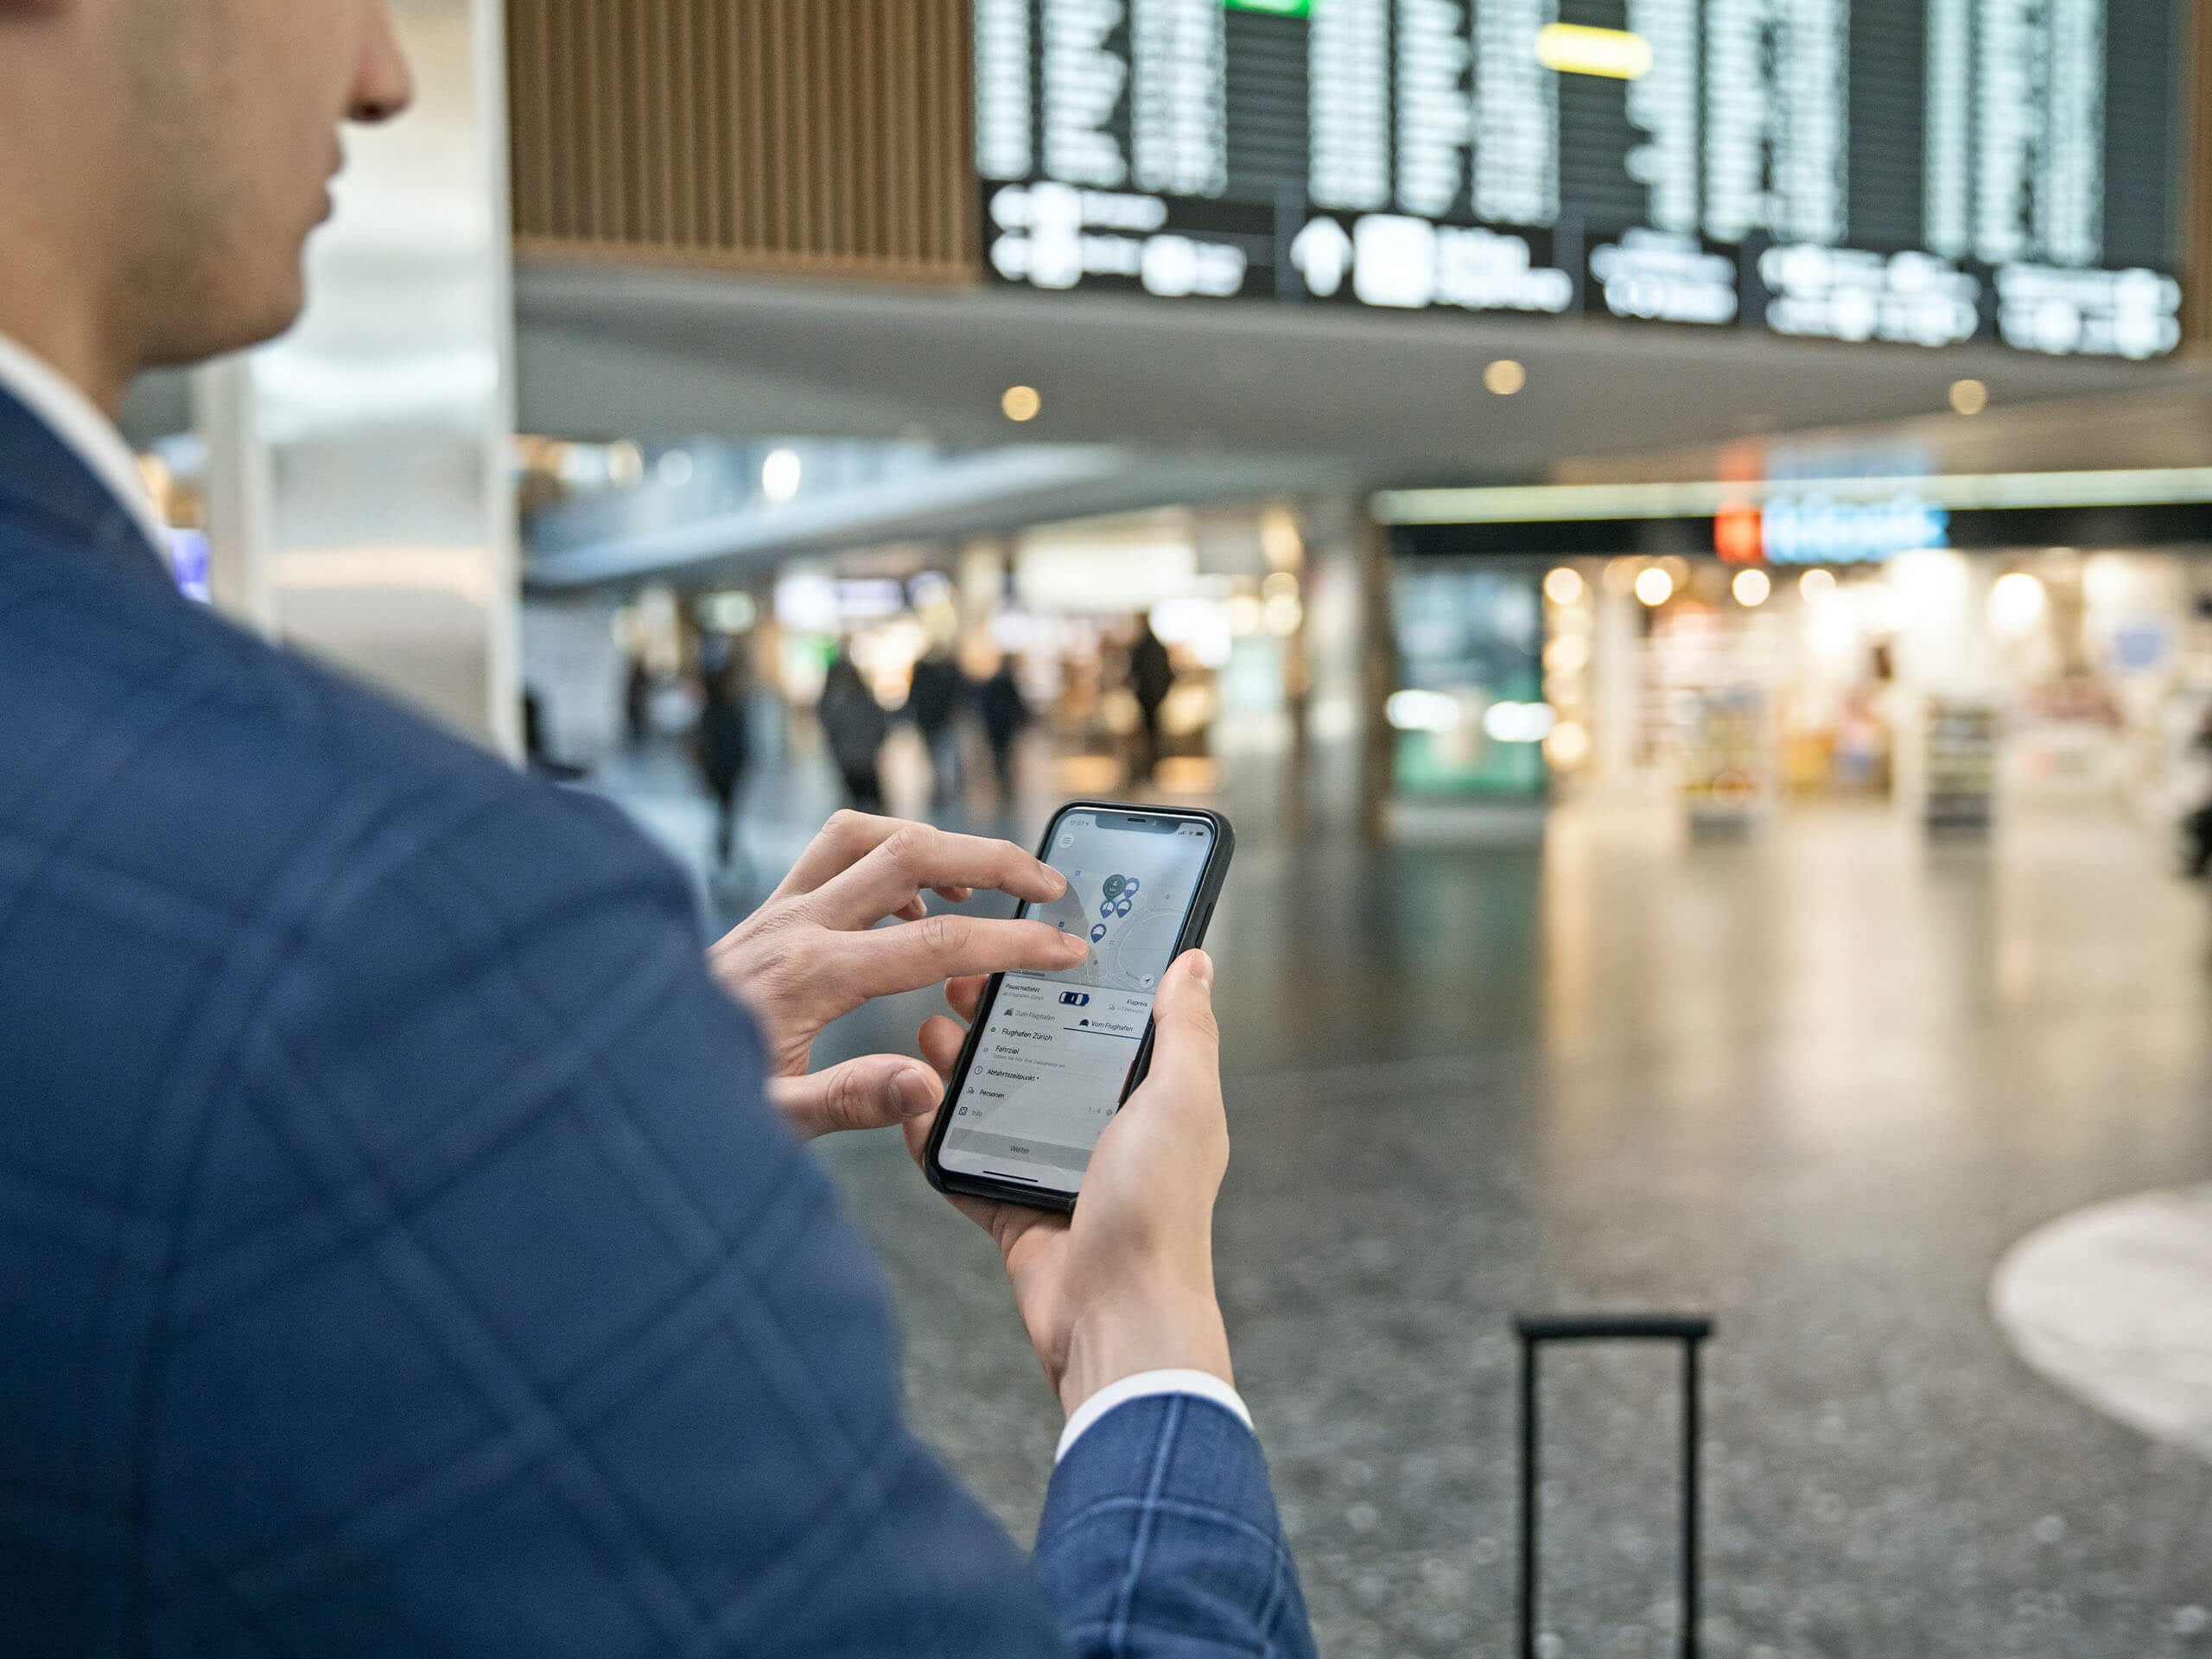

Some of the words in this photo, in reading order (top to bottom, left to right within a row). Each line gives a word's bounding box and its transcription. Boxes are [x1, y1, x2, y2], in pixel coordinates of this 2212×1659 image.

[1105, 1022, 1134, 1032] Flughafen
[1002, 1027, 1032, 1038] Flughafen
[1032, 1032, 1052, 1041] Zürich
[995, 1045, 1020, 1055] Fahrziel
[987, 1069, 1035, 1081] Abfahrtszeitpunkt
[979, 1089, 1005, 1098] Personen
[1010, 1144, 1030, 1154] Weiter
